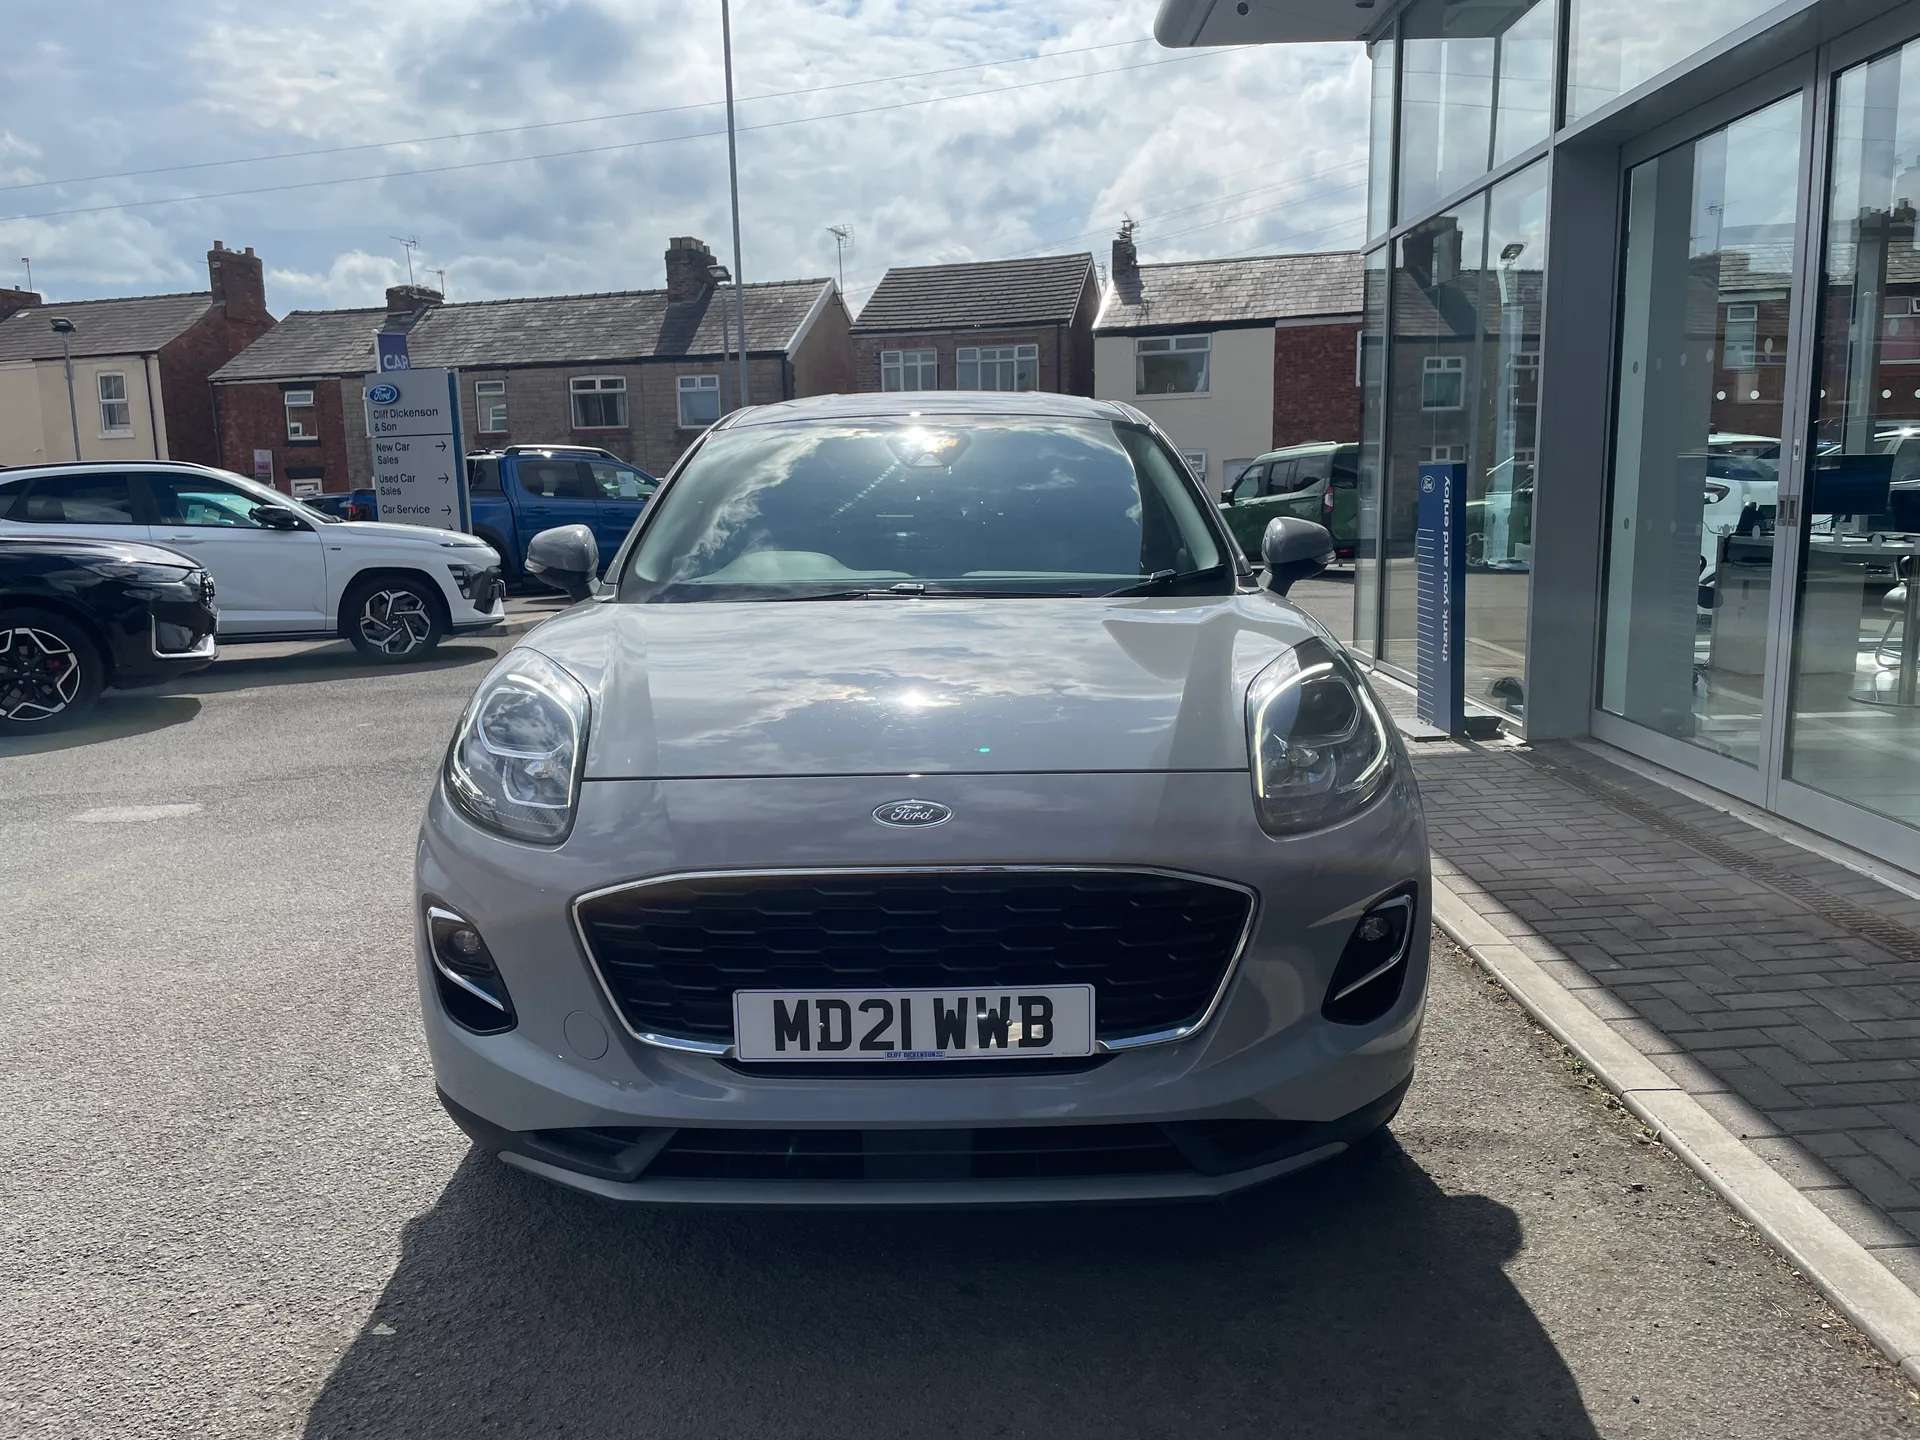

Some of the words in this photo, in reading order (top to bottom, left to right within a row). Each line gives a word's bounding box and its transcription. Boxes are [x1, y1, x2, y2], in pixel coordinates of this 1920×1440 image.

[374, 387, 391, 401] Ford
[373, 409, 388, 420] Cliff
[389, 408, 439, 418] Dickenson
[375, 423, 380, 432] &
[382, 422, 397, 432] Son
[376, 443, 393, 453] New
[395, 442, 410, 452] Car
[377, 456, 399, 465] Sales
[380, 473, 398, 484] Used
[400, 473, 416, 483] Car
[380, 486, 402, 496] Sales
[1443, 475, 1451, 528] enjoy
[382, 504, 395, 514] Car
[396, 504, 430, 514] Service
[890, 804, 934, 821] Ford
[773, 998, 912, 1052] MD21
[933, 994, 1054, 1050] WWB
